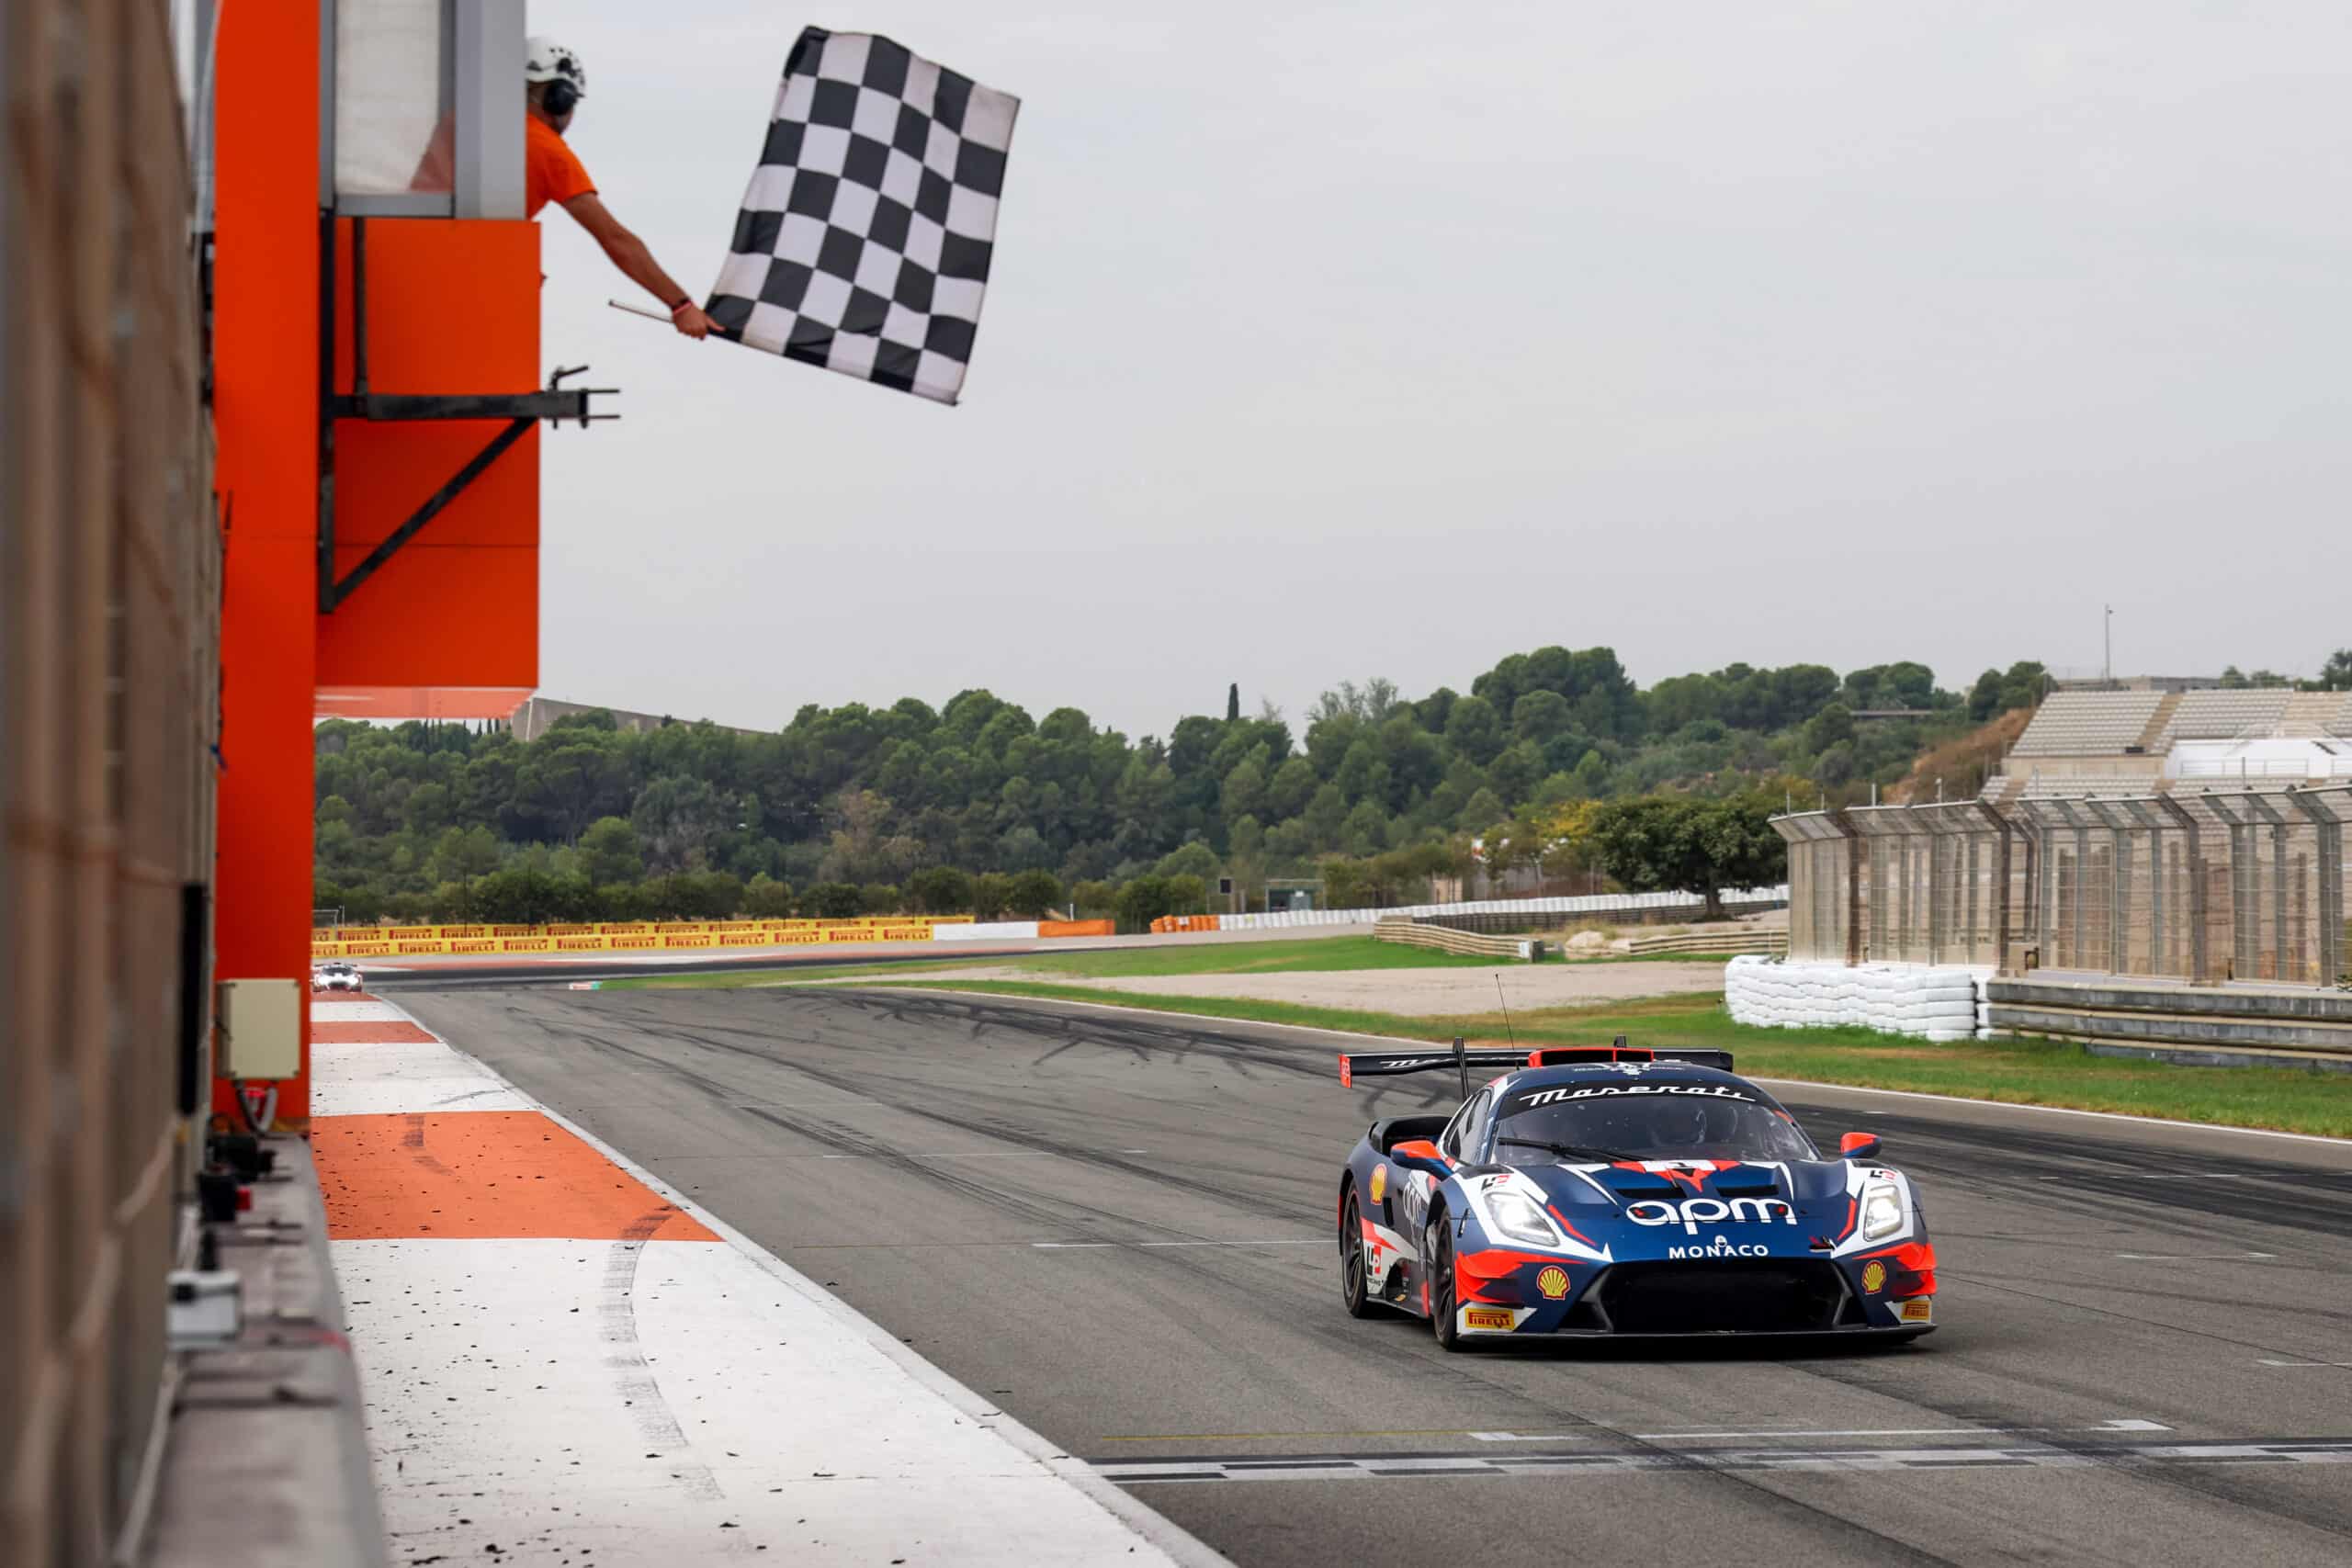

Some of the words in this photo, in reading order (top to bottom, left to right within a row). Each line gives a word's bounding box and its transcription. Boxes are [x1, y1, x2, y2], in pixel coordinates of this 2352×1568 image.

[346, 943, 390, 954] PIRELLI
[399, 942, 441, 953] PIRELLI
[451, 941, 494, 952] PIRELLI
[503, 940, 548, 951] PIRELLI
[557, 938, 601, 949] PIRELLI
[611, 937, 655, 948] PIRELLI
[665, 936, 709, 946] PIRELLI
[720, 933, 764, 944] PIRELLI
[775, 932, 820, 942] PIRELLI
[829, 930, 874, 941] PIRELLI
[884, 929, 929, 940] PIRELLI
[1520, 1085, 1756, 1106] Maserati
[1626, 1198, 1797, 1235] apm
[1668, 1245, 1769, 1259] MONACO
[1469, 1313, 1510, 1326] PIRELLI
